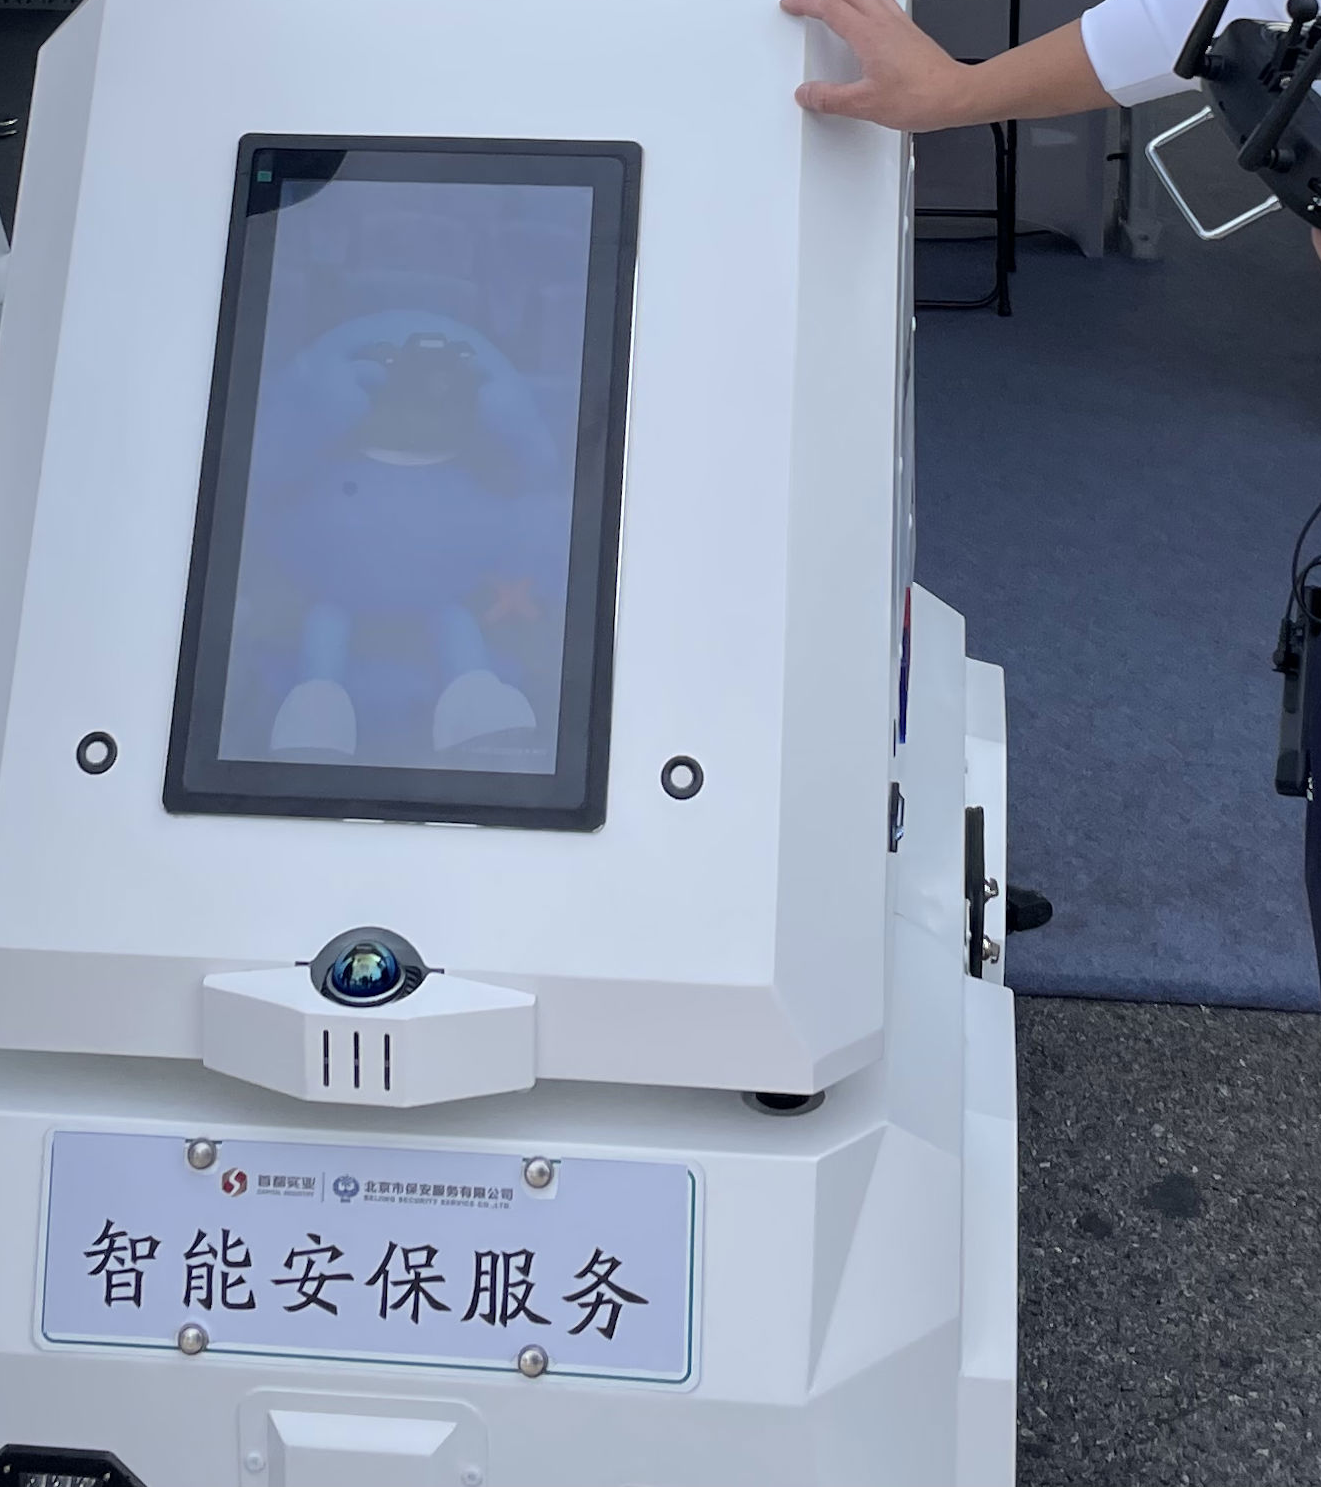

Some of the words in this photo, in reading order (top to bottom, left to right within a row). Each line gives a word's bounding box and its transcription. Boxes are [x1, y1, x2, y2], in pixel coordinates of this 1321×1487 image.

[364, 1180, 514, 1202] 北京市保安服务有限公司
[84, 1218, 650, 1342] 智能安保服务
